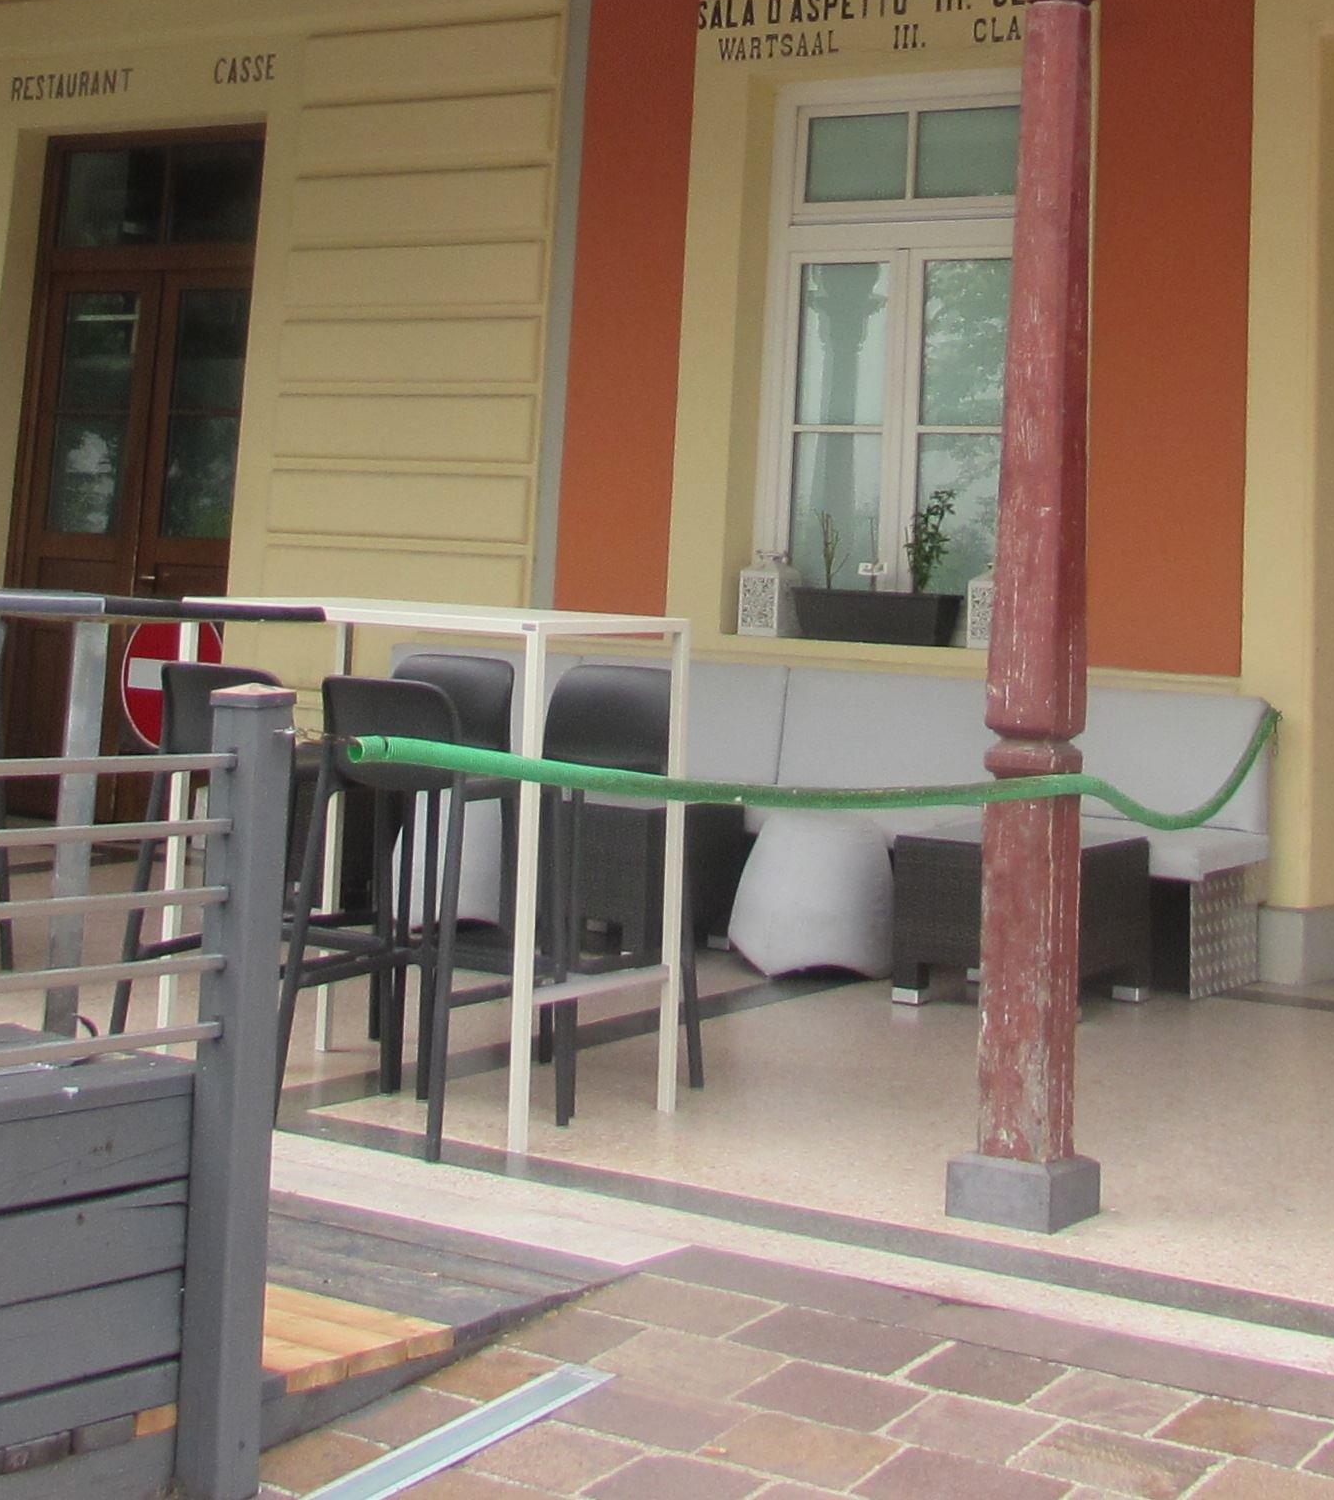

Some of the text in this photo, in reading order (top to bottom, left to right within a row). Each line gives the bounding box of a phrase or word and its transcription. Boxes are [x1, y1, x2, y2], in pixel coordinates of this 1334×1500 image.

[718, 15, 1022, 60] WARTSAAL III. CLA
[10, 54, 276, 101] RESTAURANT CASSE
